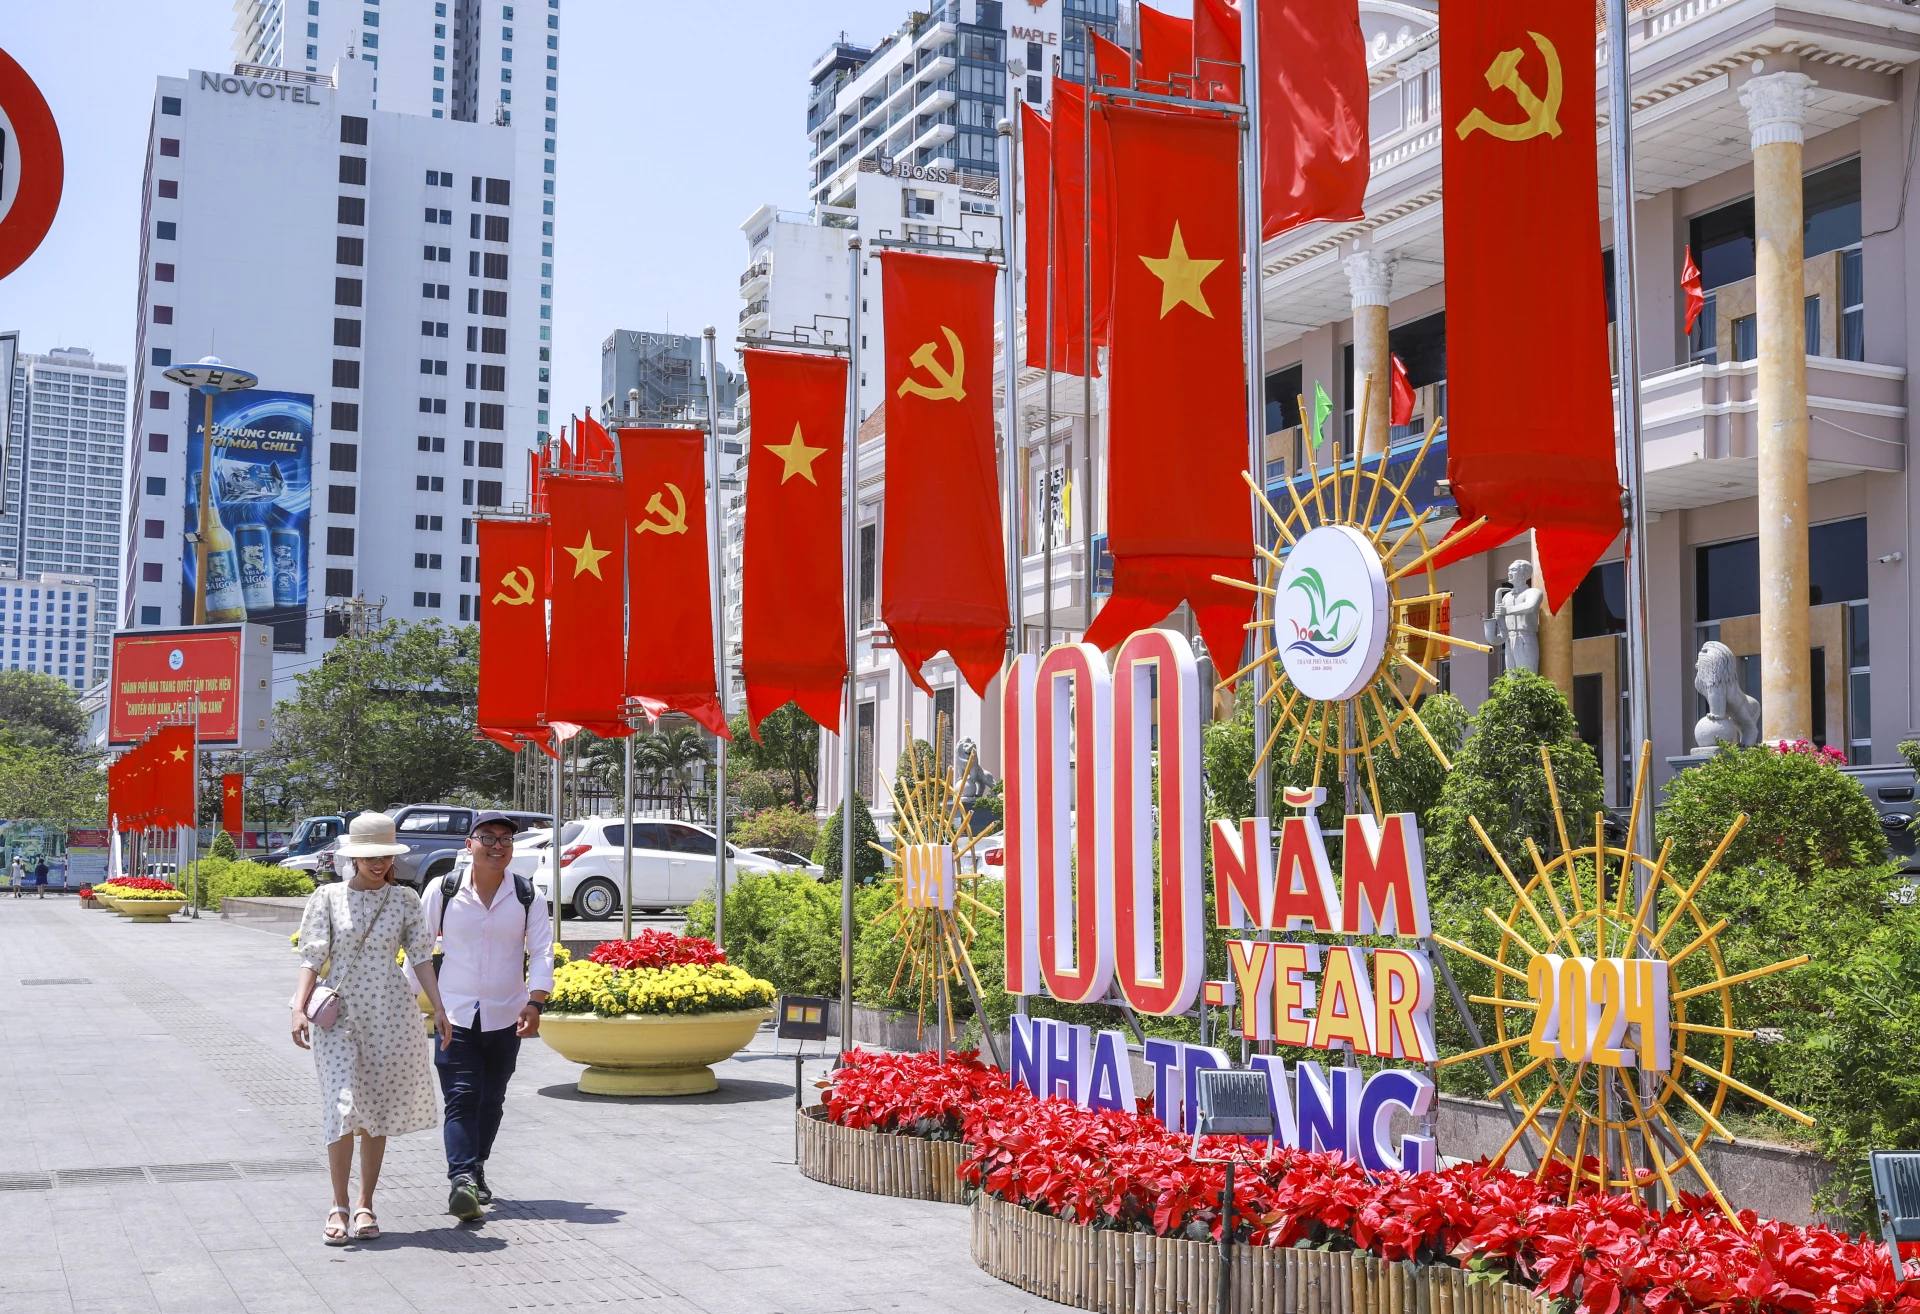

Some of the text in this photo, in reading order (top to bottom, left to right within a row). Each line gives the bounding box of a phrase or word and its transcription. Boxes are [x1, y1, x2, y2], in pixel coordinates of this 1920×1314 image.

[1012, 25, 1057, 46] MAPLE
[201, 71, 320, 105] NOVOTEL
[899, 162, 948, 183] BOSS
[629, 332, 680, 349] VENUE
[222, 426, 266, 439] THÙNG
[268, 430, 303, 442] CHILL
[229, 437, 258, 449] MÙA
[261, 441, 297, 452] CHILL
[149, 681, 159, 693] NHA
[160, 680, 176, 693] TRANG
[177, 676, 192, 693] QUYẾT
[1003, 628, 1204, 1016] 100
[1210, 787, 1432, 938] NĂM
[901, 844, 954, 910] 1924
[1528, 954, 1671, 1072] 2024
[1010, 1014, 1138, 1114] NHA
